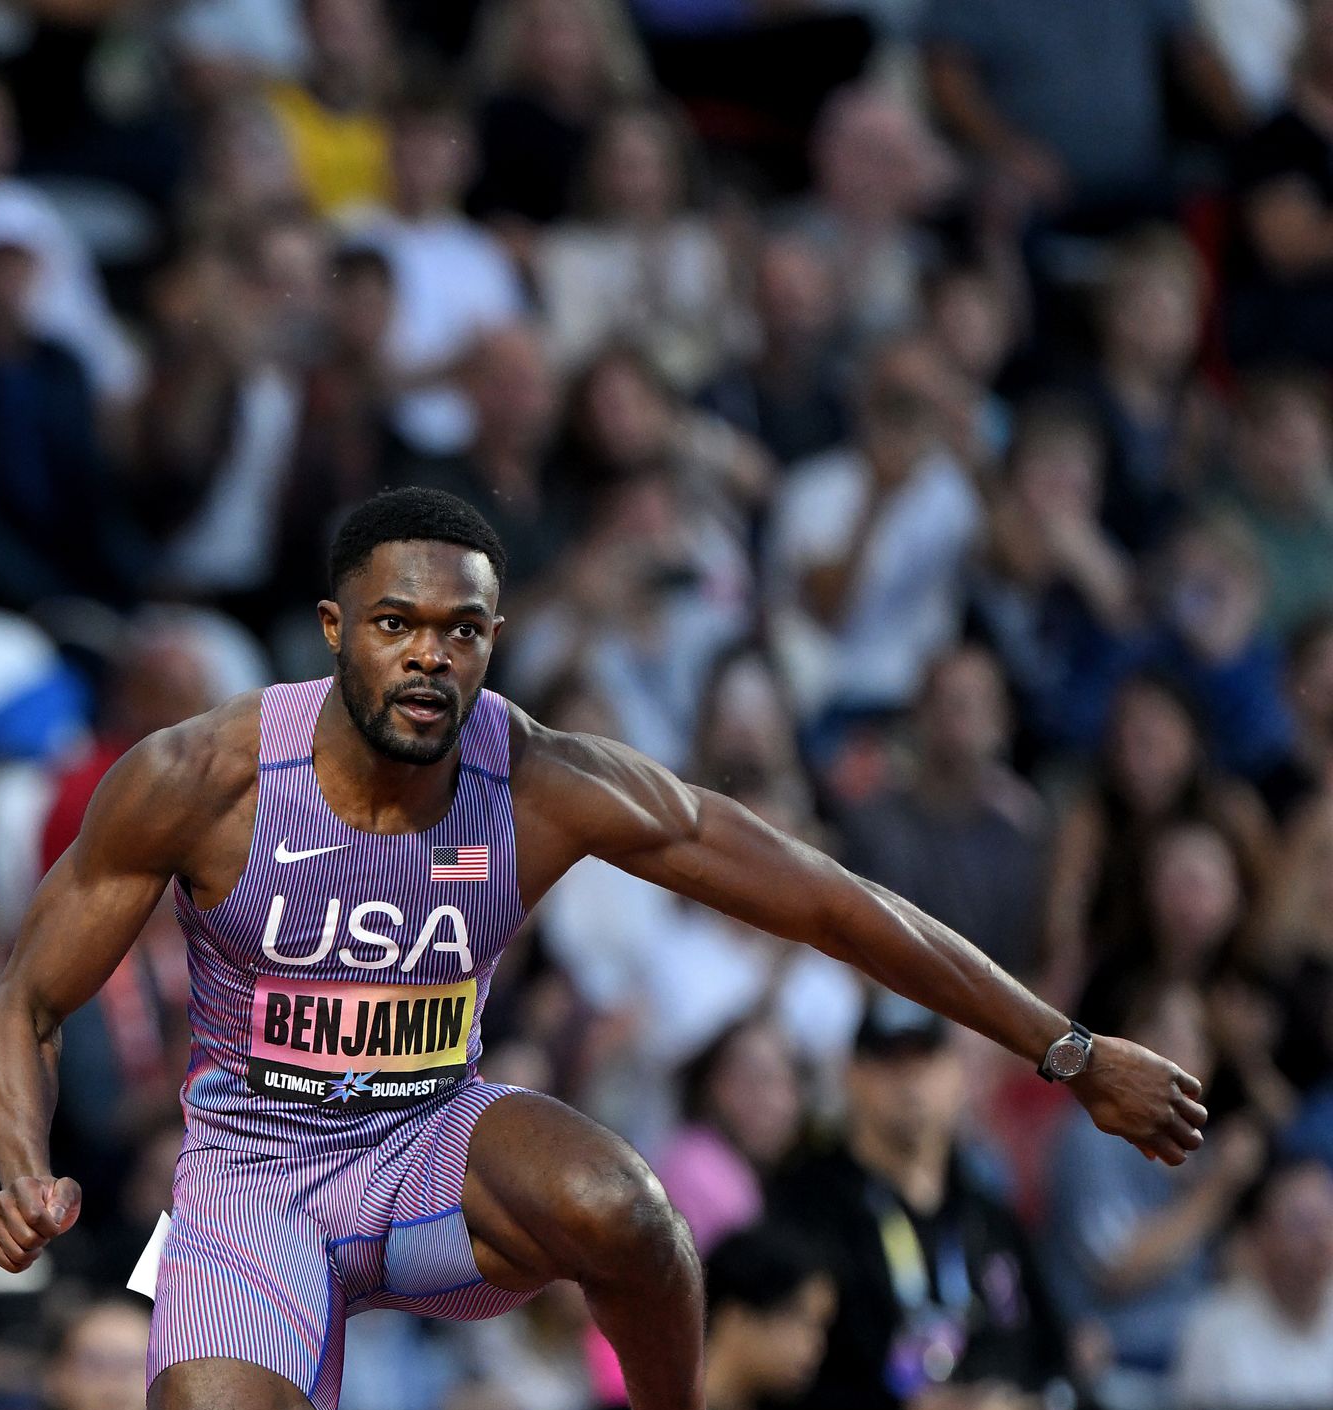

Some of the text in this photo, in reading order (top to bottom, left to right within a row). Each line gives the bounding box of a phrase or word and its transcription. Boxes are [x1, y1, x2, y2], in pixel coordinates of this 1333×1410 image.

[261, 894, 474, 973] USA
[264, 992, 466, 1058] BENJAMIN
[264, 1070, 326, 1096] ULTIMATE
[371, 1078, 437, 1097] BUDAPEST
